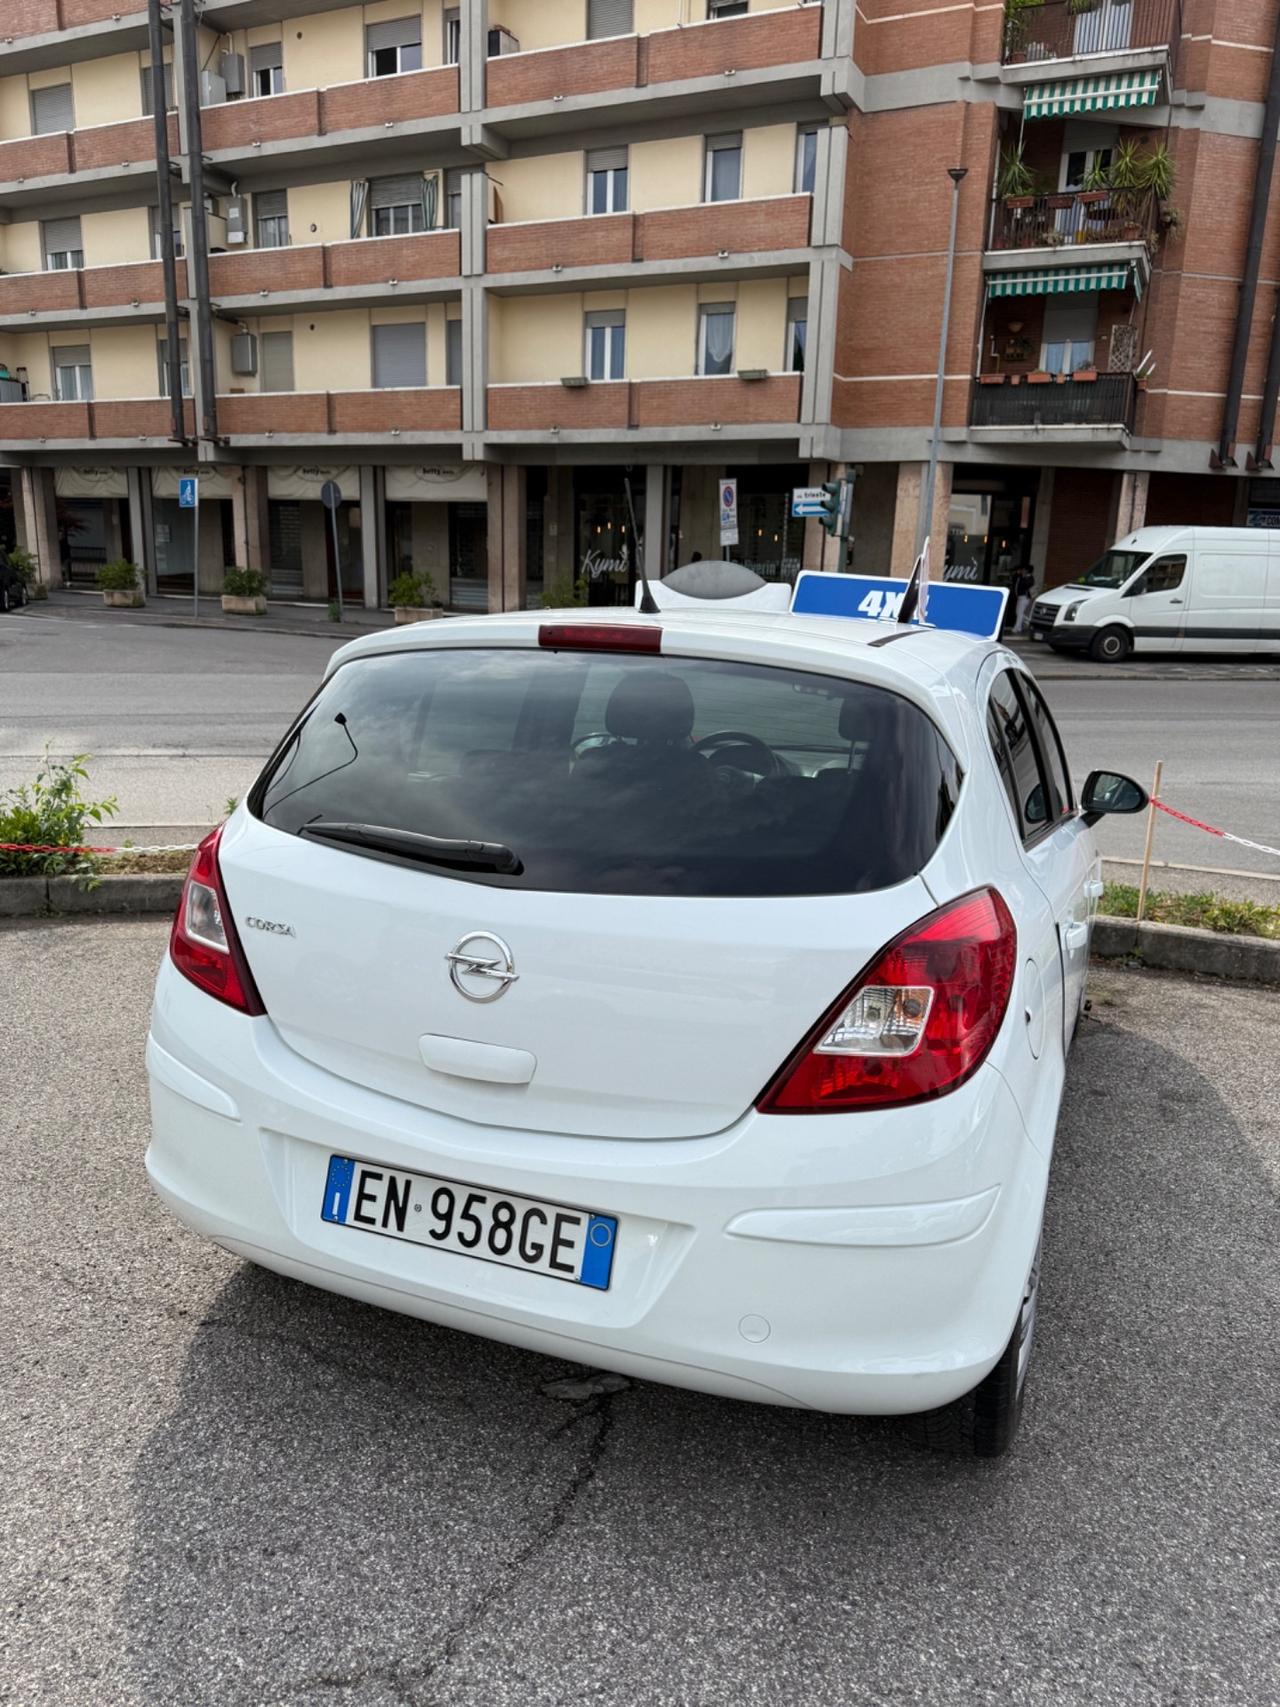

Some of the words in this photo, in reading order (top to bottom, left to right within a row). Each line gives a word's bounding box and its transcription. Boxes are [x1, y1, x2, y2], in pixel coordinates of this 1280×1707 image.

[943, 556, 978, 582] ymì
[245, 916, 296, 937] CORSA
[353, 1169, 412, 1232] EN
[428, 1186, 581, 1273] 958GE
